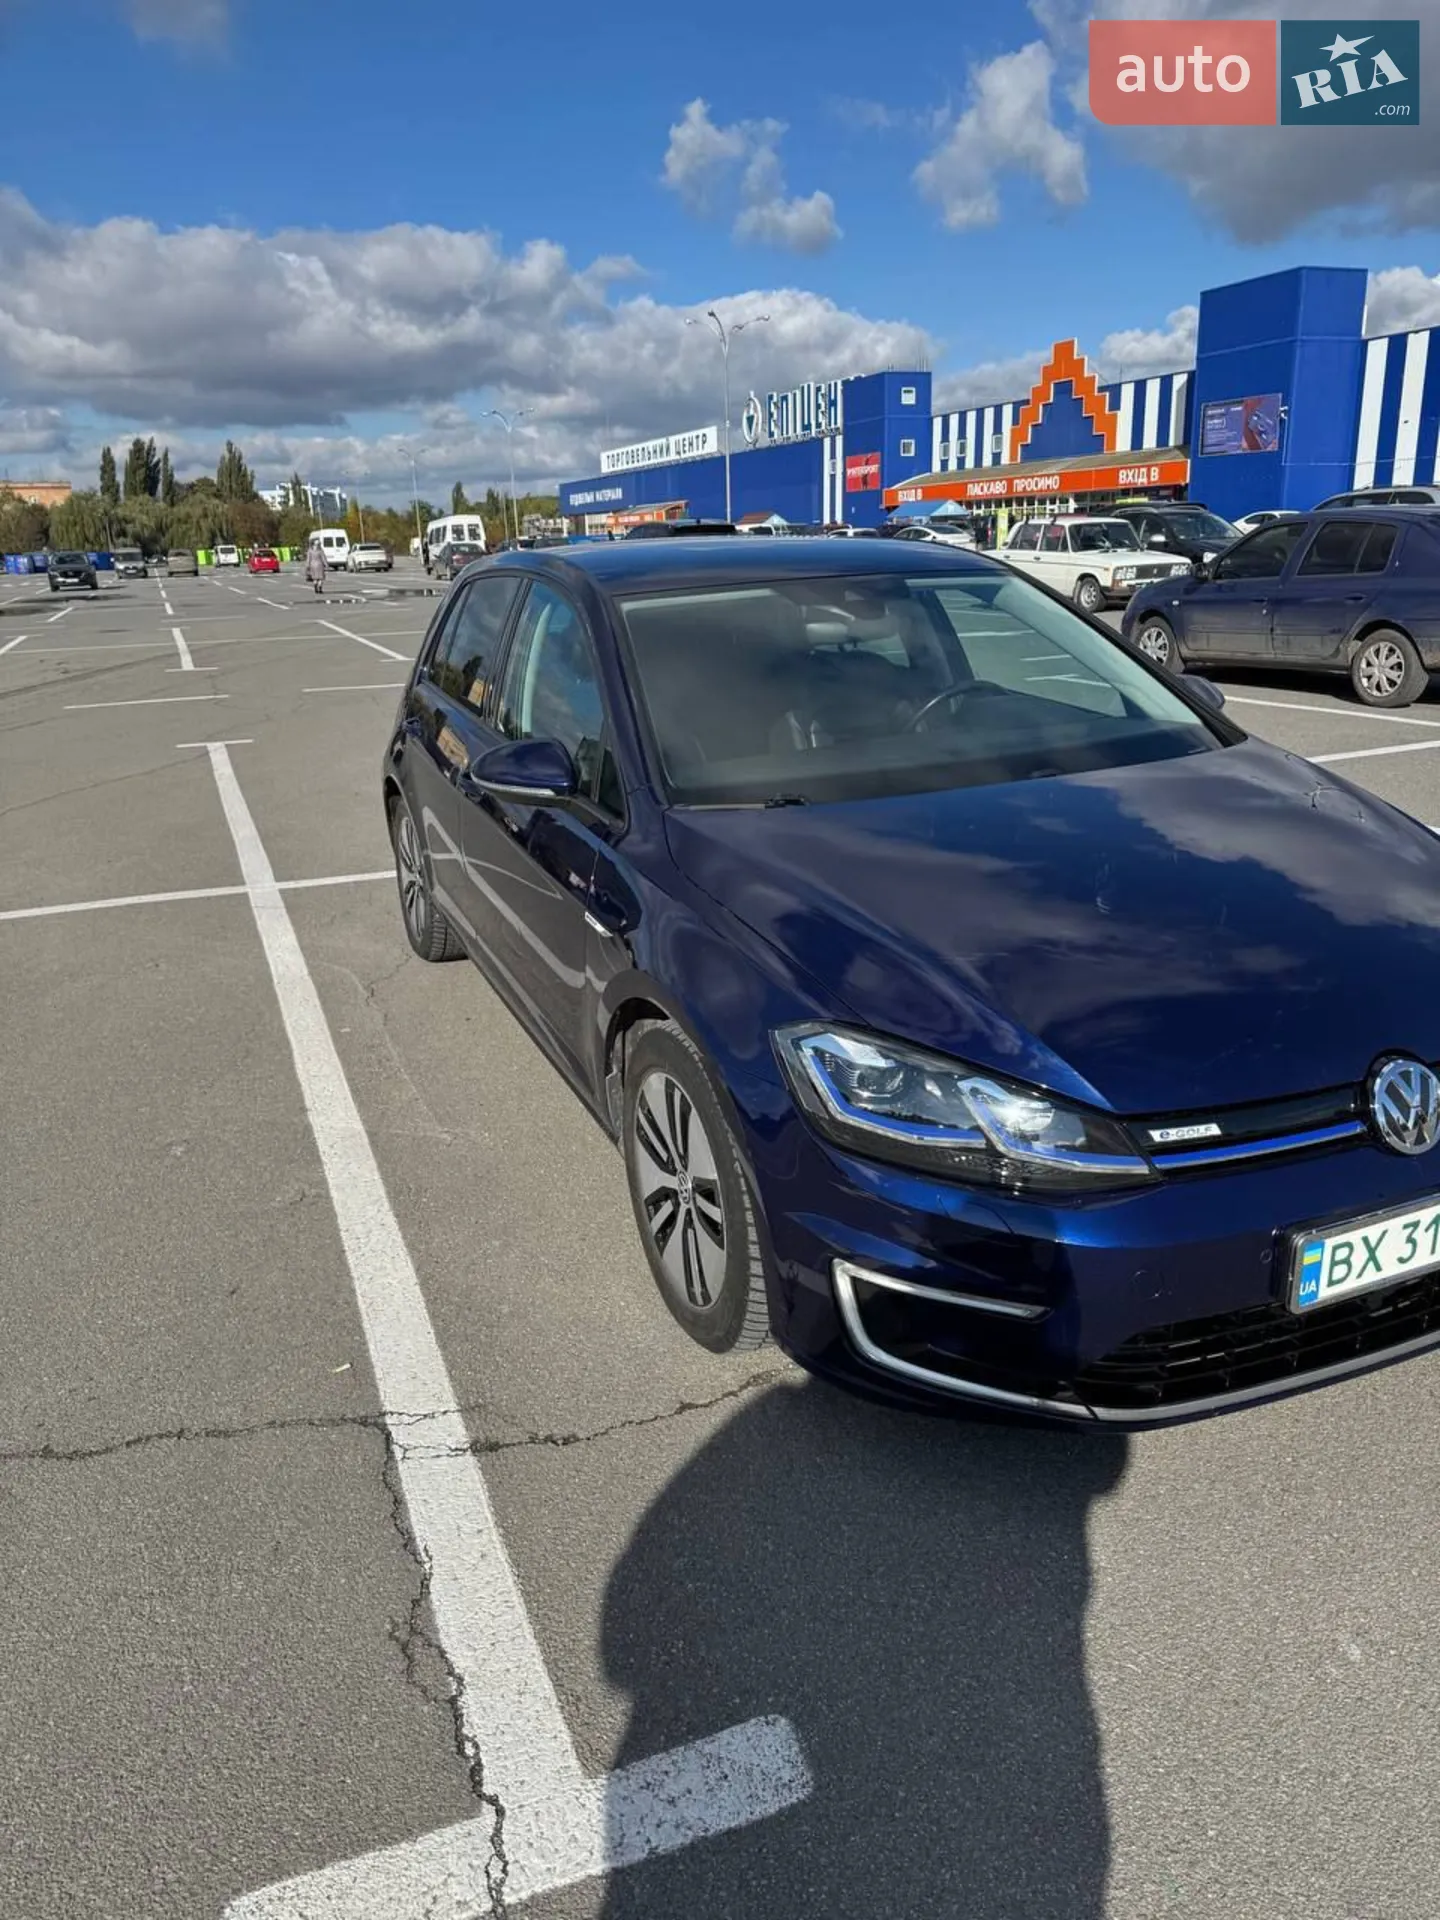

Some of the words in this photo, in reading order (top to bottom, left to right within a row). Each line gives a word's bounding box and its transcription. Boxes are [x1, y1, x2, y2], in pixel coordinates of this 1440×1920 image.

[766, 379, 852, 439] ЕПІЦЕН
[606, 439, 671, 469] ТОРГОВЕЛЬНИЙ
[674, 433, 708, 457] ЦЕНТР
[966, 479, 1008, 497] ЛАСКАВО
[1013, 475, 1060, 493] ПРОСИМО
[1118, 468, 1148, 485] ВХІД
[1150, 466, 1160, 482] В
[1326, 1229, 1389, 1288] BX
[1396, 1212, 1440, 1265] 31
[1299, 1281, 1317, 1296] UA
